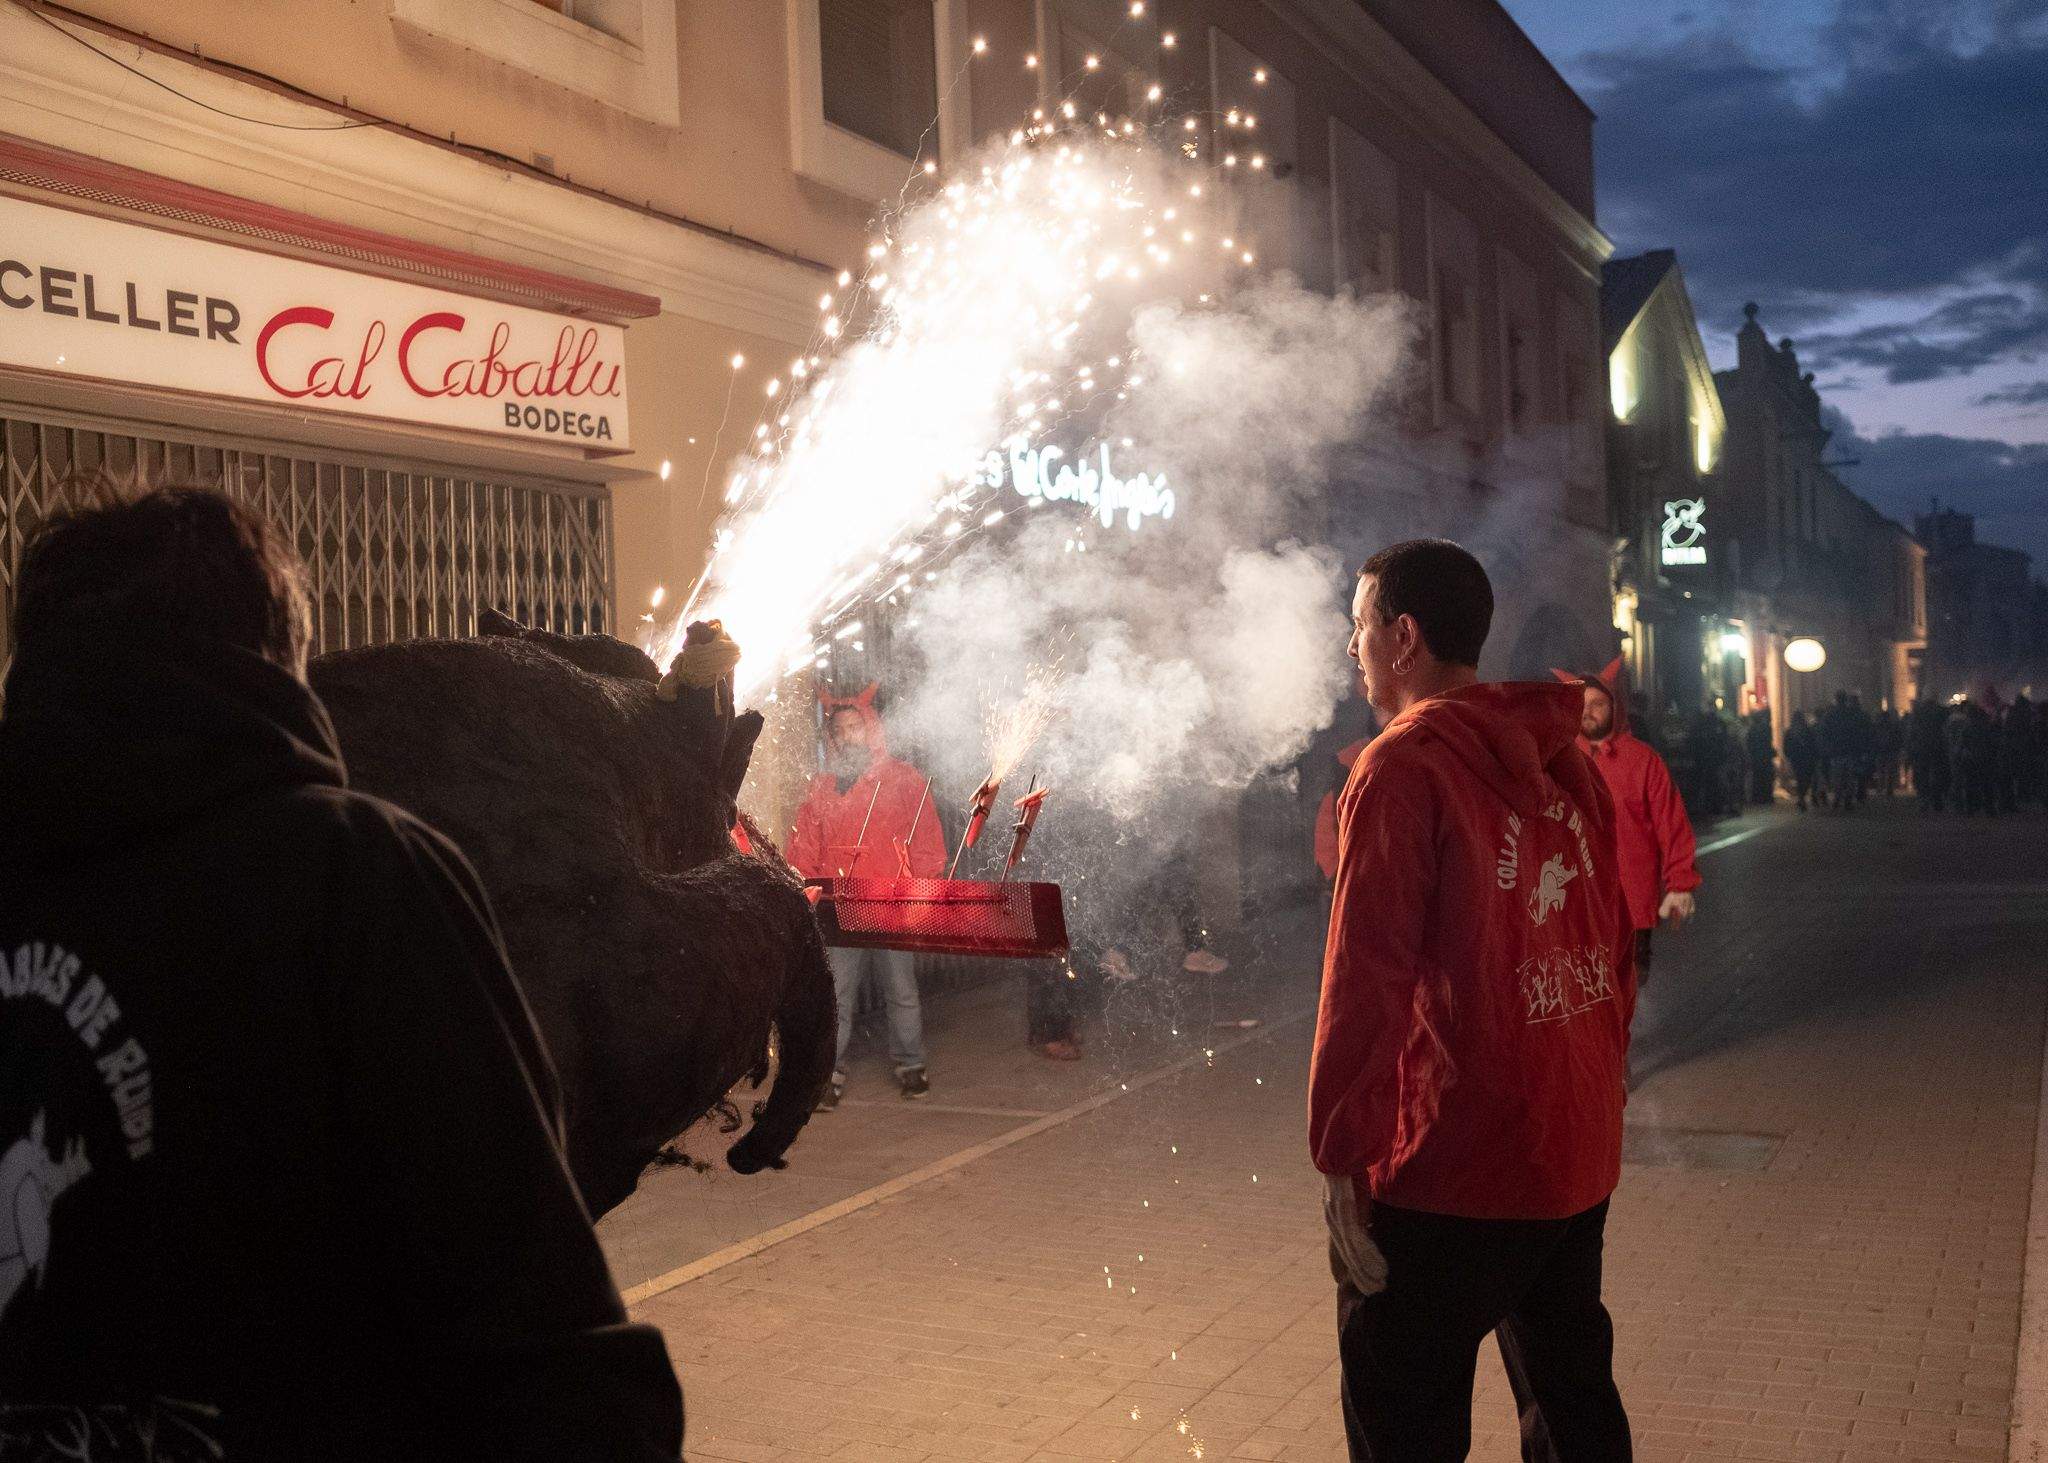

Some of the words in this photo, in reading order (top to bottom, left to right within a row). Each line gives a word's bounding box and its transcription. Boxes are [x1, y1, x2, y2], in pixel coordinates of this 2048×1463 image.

[0, 259, 241, 345] CELLER
[256, 306, 386, 400] Cal
[398, 312, 620, 398] Caballu
[504, 402, 612, 440] BODEGA
[1497, 833, 1518, 890] COLLA
[64, 971, 121, 1050] DE
